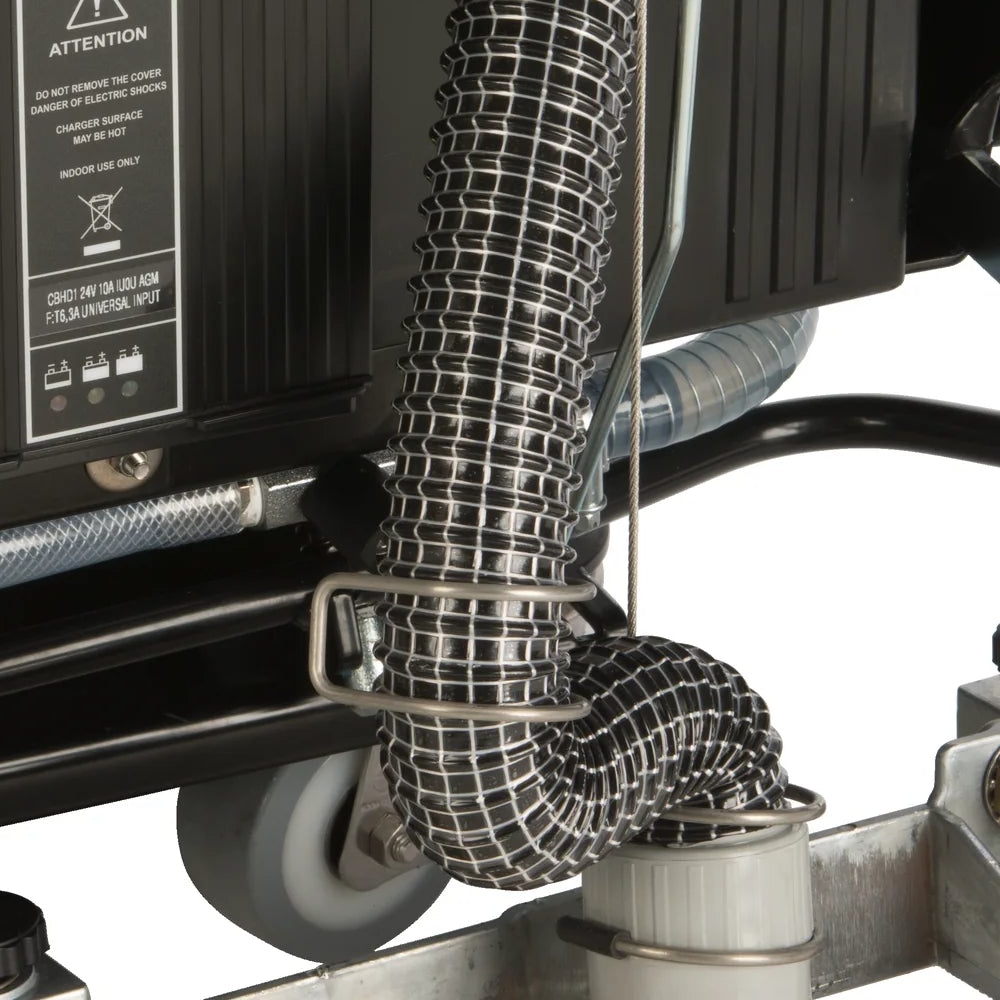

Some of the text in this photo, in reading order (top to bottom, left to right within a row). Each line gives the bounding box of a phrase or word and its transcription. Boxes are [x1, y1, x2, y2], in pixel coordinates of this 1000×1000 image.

[49, 26, 148, 57] ATTENTION
[31, 81, 167, 116] DANGER OF ELECTRIC SHOCKS
[36, 68, 162, 101] DO NOT REMOVE THE COVER
[56, 110, 143, 134] CHARGER SURFACE
[73, 127, 127, 145] MAY BE HOT
[60, 156, 141, 179] INDOOR USE ONLY
[47, 291, 78, 307] CBHD1
[80, 284, 97, 300] 24V
[99, 280, 115, 295] 10A
[138, 271, 159, 287] AGM
[82, 296, 131, 319] UNIVERSAL
[133, 289, 161, 307] INPUT
